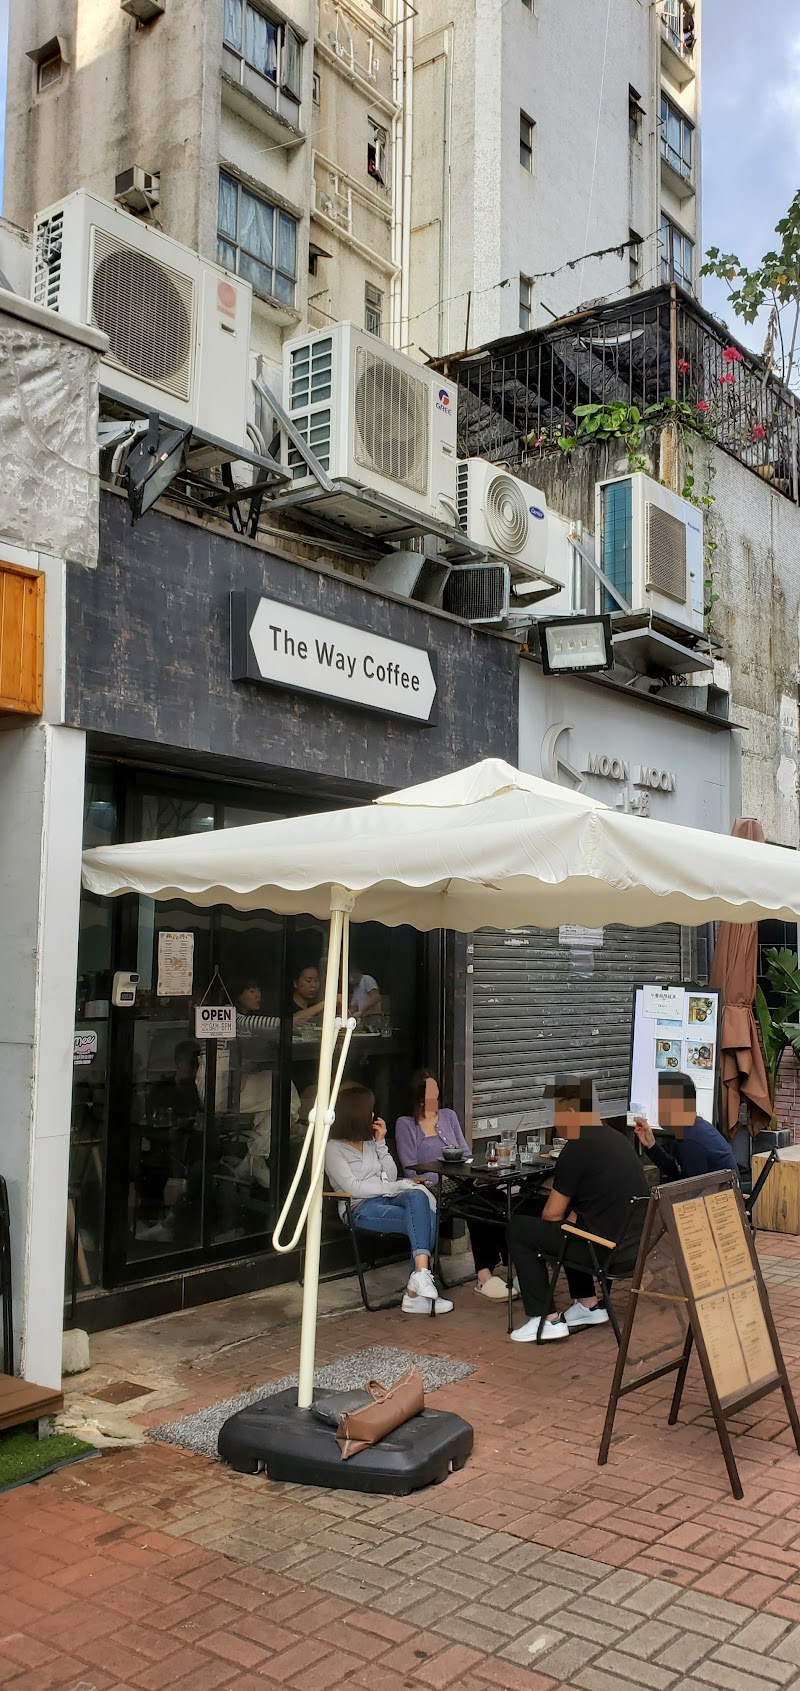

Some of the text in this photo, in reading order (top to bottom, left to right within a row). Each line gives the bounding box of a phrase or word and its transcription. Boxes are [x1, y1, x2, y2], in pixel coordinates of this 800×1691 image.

[435, 402, 452, 416] GREE
[268, 624, 421, 692] The Way Coffee
[583, 751, 677, 793] MOON MOON
[201, 1009, 232, 1021] OPEN
